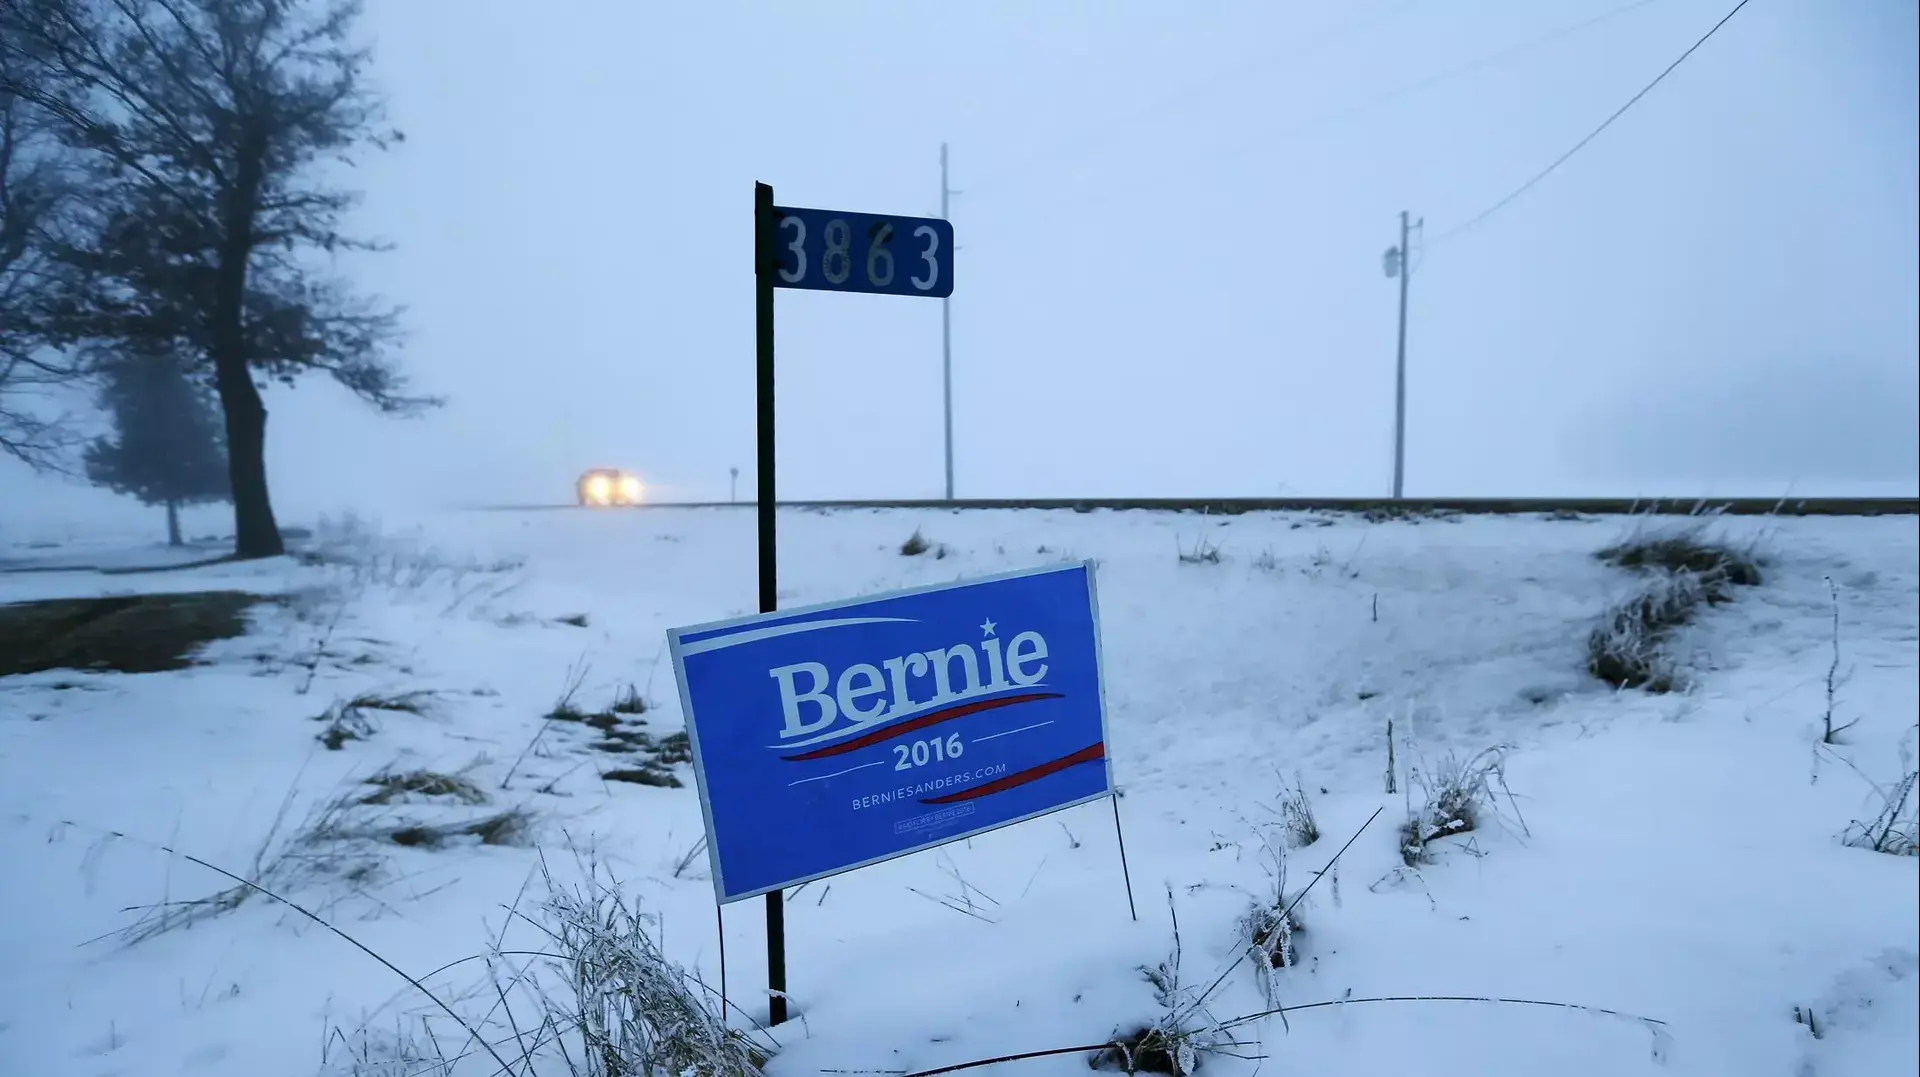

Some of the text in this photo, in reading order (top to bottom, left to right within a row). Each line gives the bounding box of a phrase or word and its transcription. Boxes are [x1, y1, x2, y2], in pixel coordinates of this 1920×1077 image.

[778, 216, 939, 298] 3863
[769, 618, 1049, 739] Bernie
[893, 733, 964, 772] 2016
[852, 763, 1006, 811] BERNIESANDERS.COM
